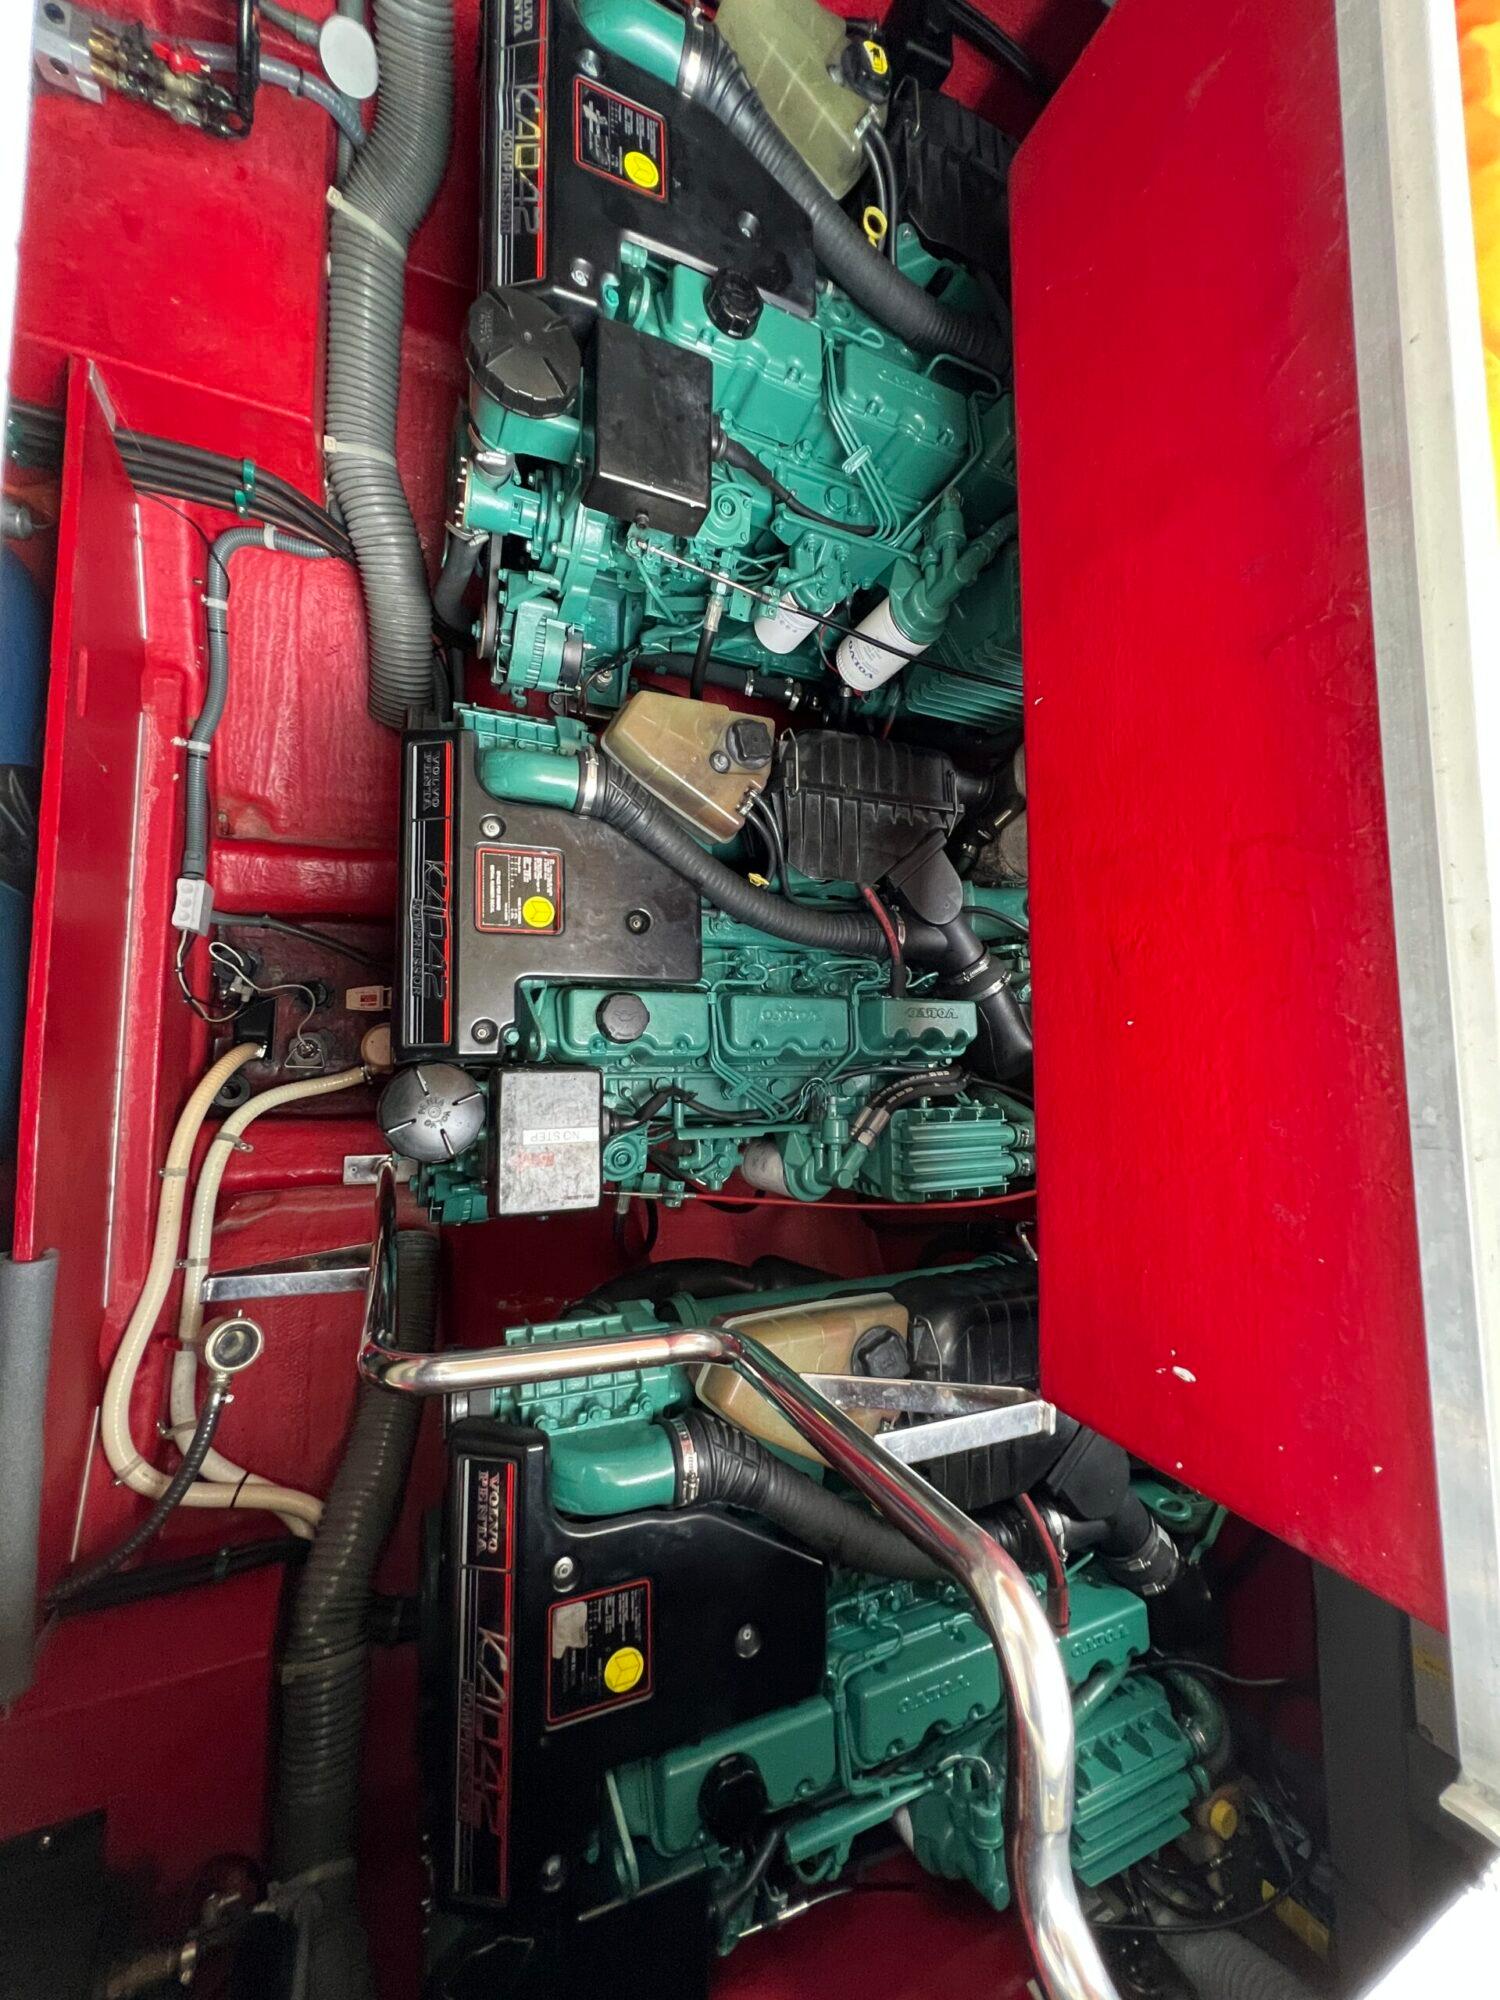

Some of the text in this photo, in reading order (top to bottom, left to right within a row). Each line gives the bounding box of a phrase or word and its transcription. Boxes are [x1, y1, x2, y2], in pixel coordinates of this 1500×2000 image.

[523, 0, 534, 32] LVO
[500, 129, 515, 235] KOMPRESSOR
[848, 639, 874, 680] VOLVO
[422, 750, 432, 811] PENTA
[431, 750, 441, 808] VOLVO
[411, 898, 423, 998] KOMPRESSOR
[423, 860, 447, 1001] KAD42
[907, 1007, 959, 1019] VOLVO
[417, 1097, 445, 1116] PENTA
[424, 1110, 452, 1129] VOLVO
[530, 1130, 580, 1143] NO STEP
[476, 1469, 489, 1556] PENTA
[488, 1471, 500, 1554] VOLVO
[475, 1627, 508, 1834] KAD42
